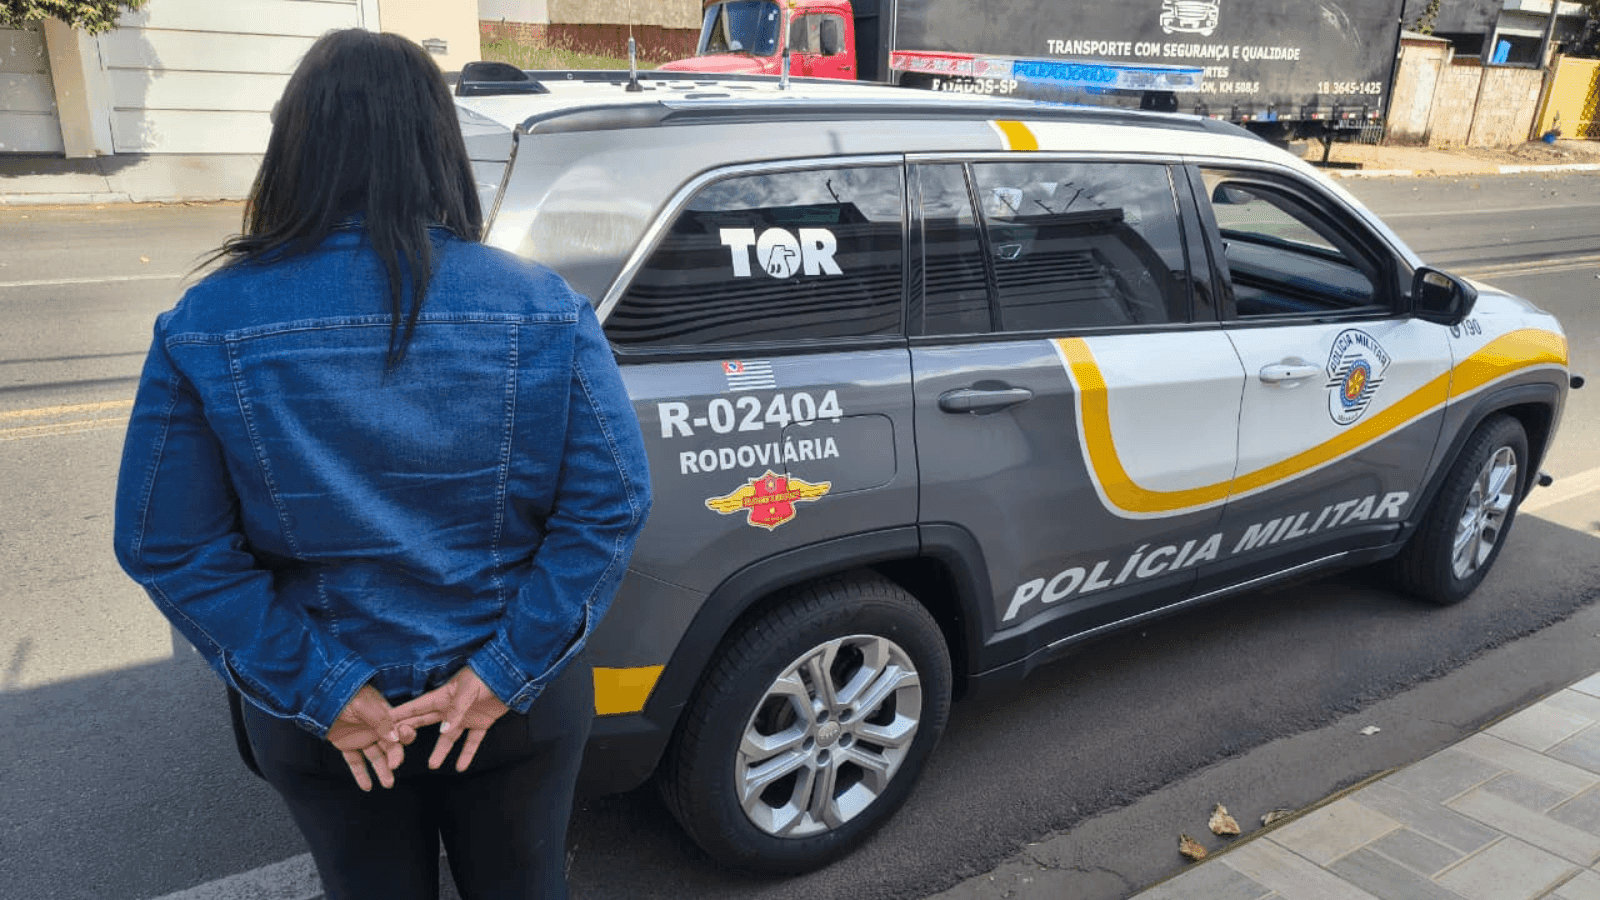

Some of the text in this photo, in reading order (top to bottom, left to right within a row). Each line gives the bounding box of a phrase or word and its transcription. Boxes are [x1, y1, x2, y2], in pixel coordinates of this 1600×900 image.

[1047, 40, 1300, 61] TRANSPORTE COM SEGURANÇA E QUALIDADE
[1219, 82, 1233, 93] KM
[1318, 81, 1330, 94] 18
[719, 228, 843, 278] TOR
[1463, 318, 1482, 336] 190
[1354, 333, 1388, 367] MILITAR
[658, 390, 843, 438] R-02404
[680, 436, 839, 474] RODOVIÁRIA
[1003, 491, 1409, 621] POLÍCIA MILITAR
